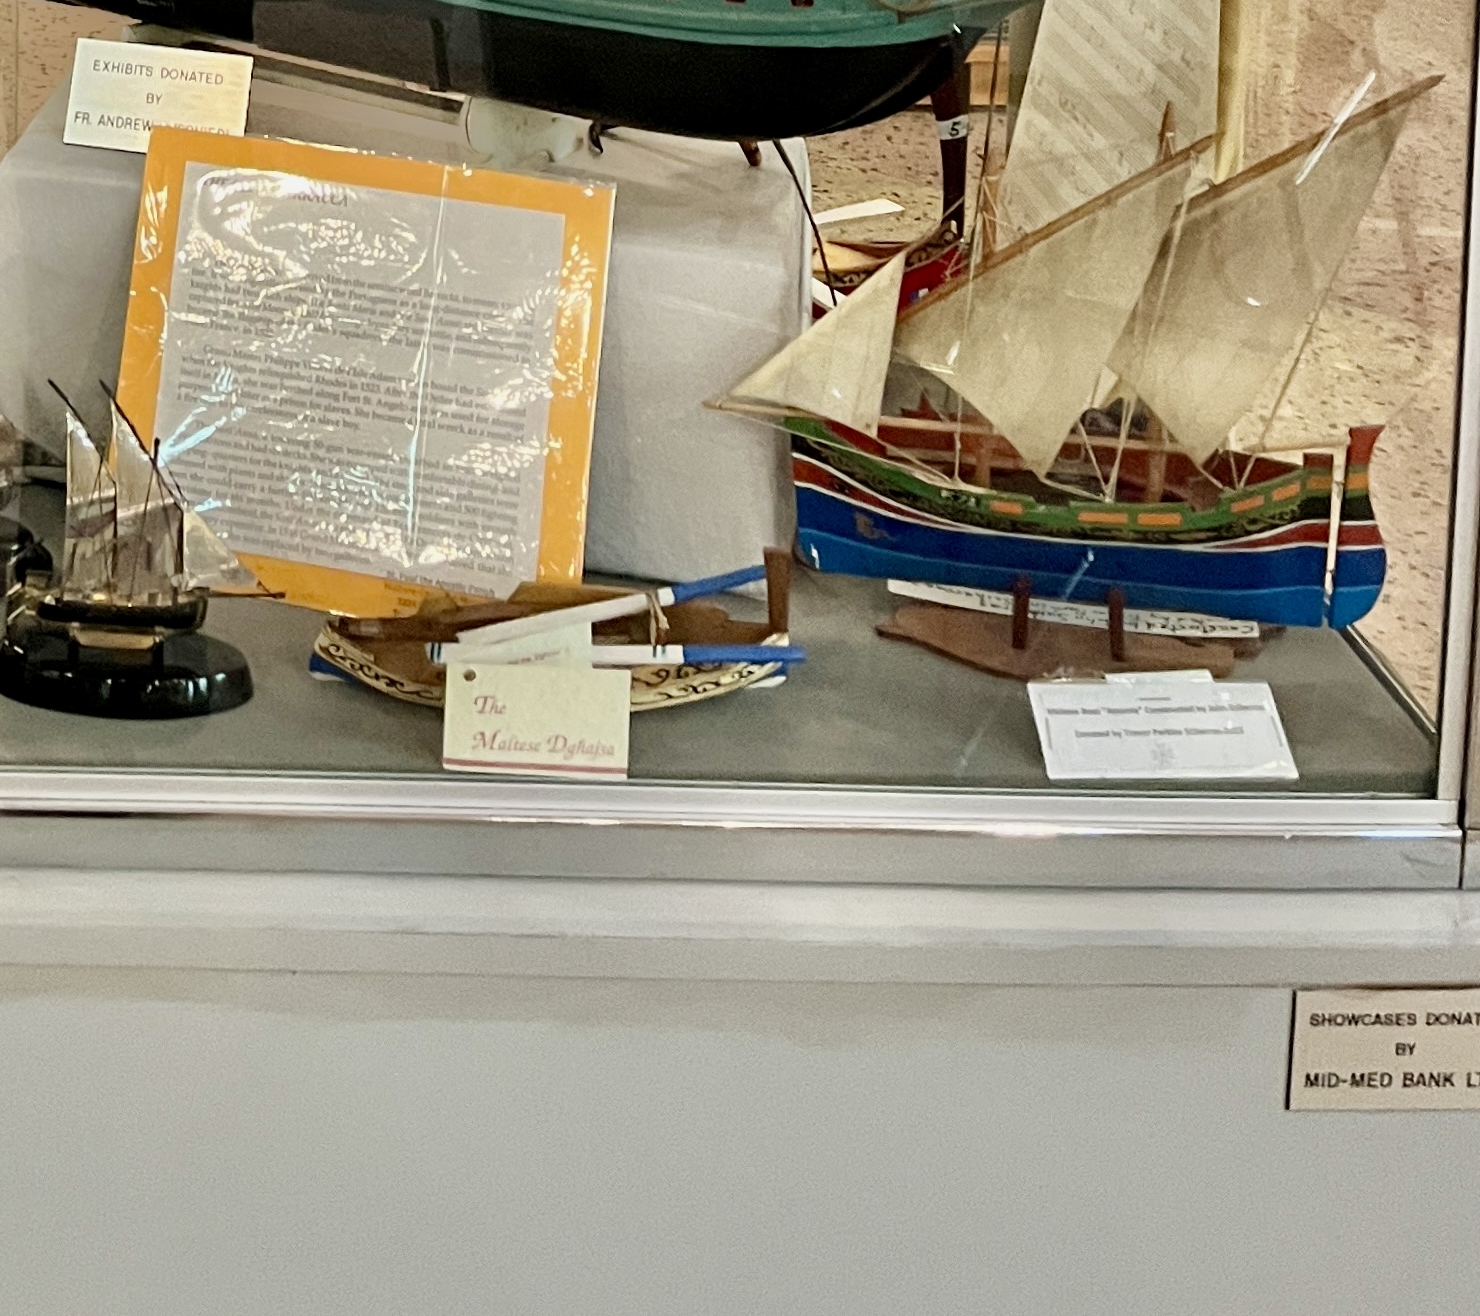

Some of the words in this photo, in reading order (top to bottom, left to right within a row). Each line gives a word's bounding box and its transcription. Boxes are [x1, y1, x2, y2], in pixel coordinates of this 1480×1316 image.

[92, 59, 154, 77] EXHIBITS
[160, 67, 224, 85] DONATED
[146, 93, 163, 105] BY
[73, 111, 92, 125] FR.
[97, 114, 151, 131] ANDREW
[948, 121, 961, 137] 5
[473, 695, 507, 715] The
[472, 729, 542, 751] Maltese
[1309, 1012, 1418, 1027] SHOWCASES
[1394, 1042, 1417, 1056] BY
[1304, 1072, 1393, 1088] MID-MED
[1402, 1072, 1456, 1088] BANK
